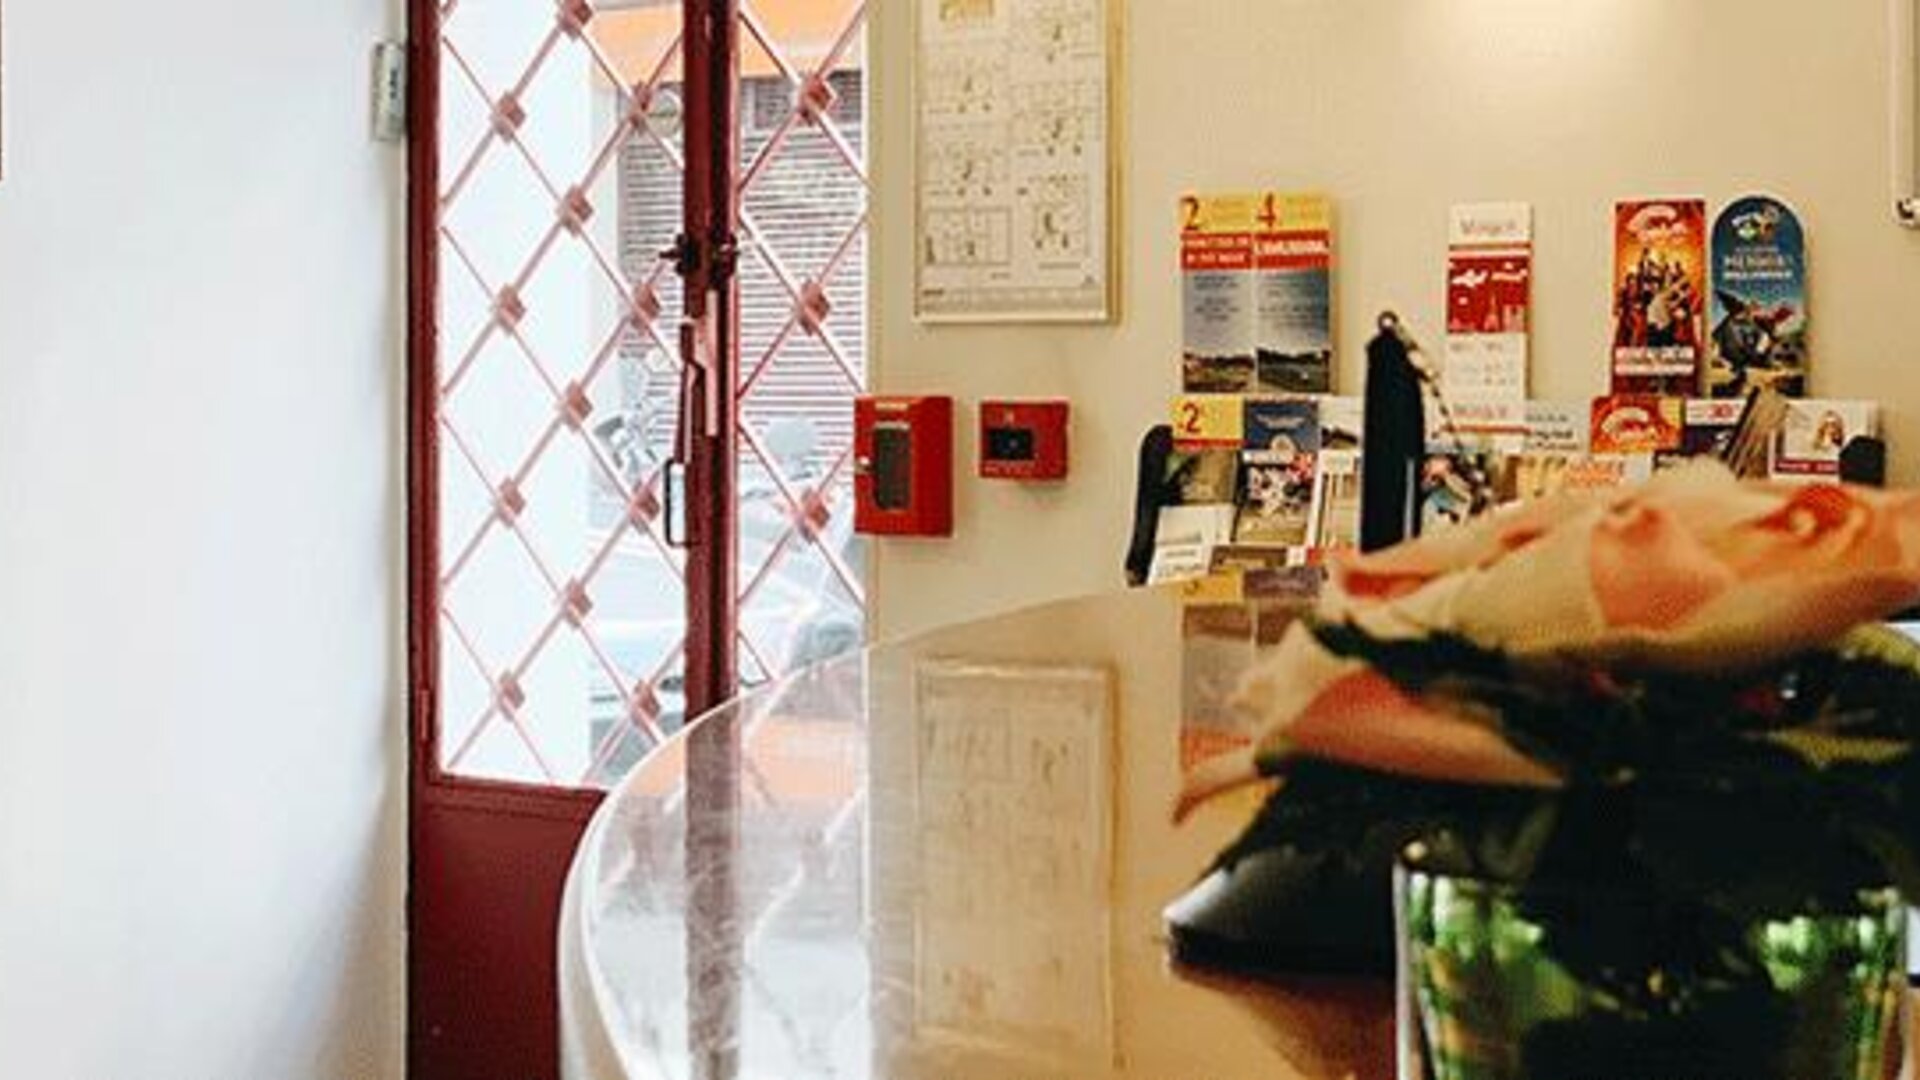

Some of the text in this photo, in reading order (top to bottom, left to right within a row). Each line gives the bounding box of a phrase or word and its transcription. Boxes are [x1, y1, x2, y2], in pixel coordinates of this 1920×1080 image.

[1180, 195, 1200, 230] 2
[1257, 191, 1276, 228] 4
[1183, 402, 1201, 432] 2
